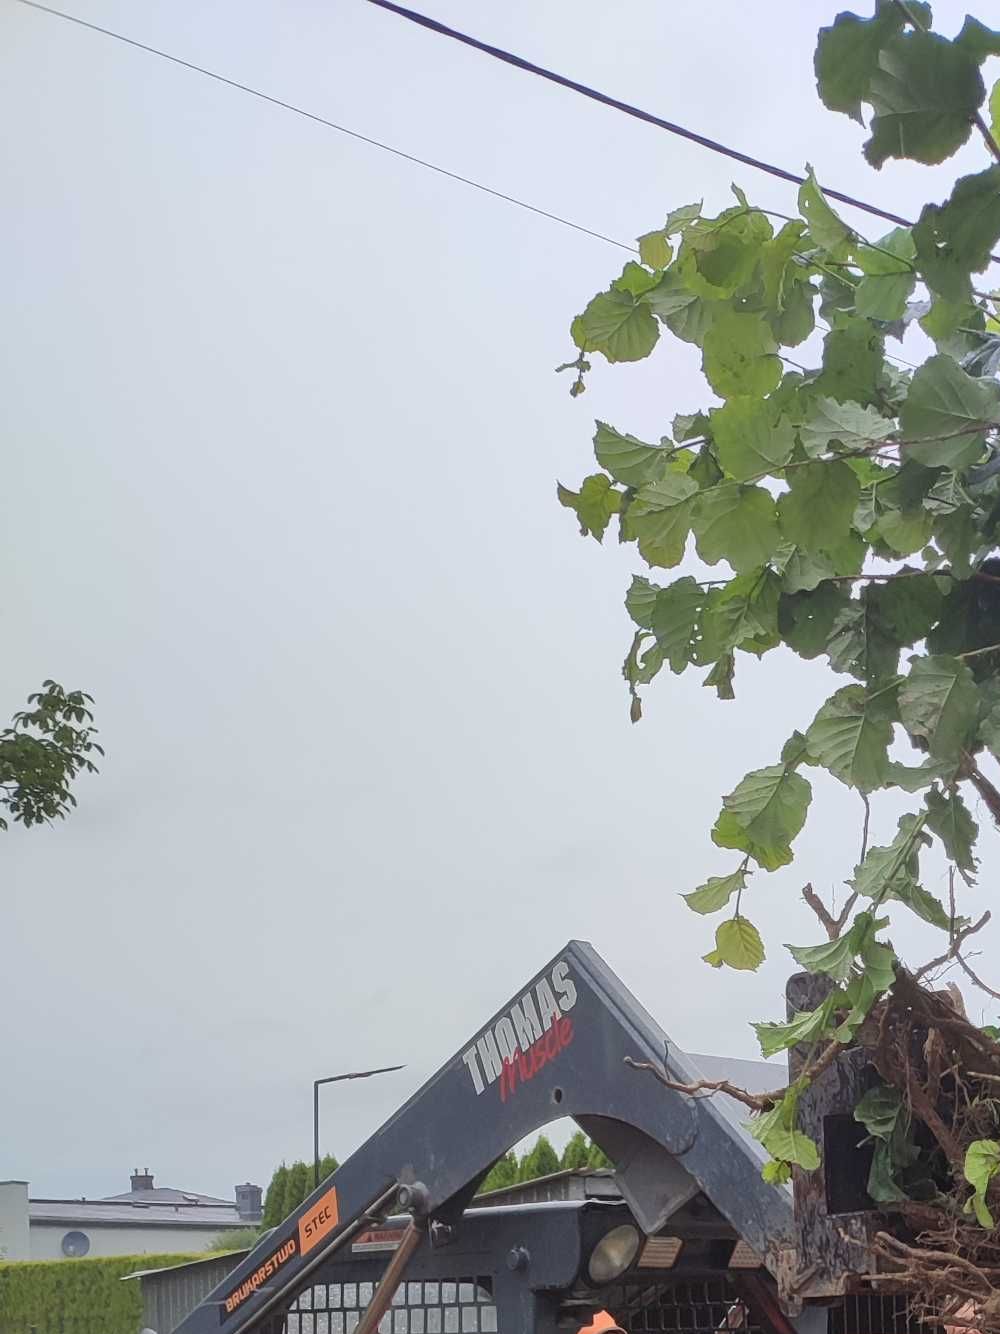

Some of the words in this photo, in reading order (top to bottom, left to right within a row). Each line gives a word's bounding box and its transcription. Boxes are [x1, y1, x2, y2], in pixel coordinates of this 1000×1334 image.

[462, 961, 577, 1095] THOMAS
[499, 1012, 573, 1103] Muscle
[225, 1239, 296, 1312] BRUKARSTWO
[304, 1206, 332, 1238] STEC
